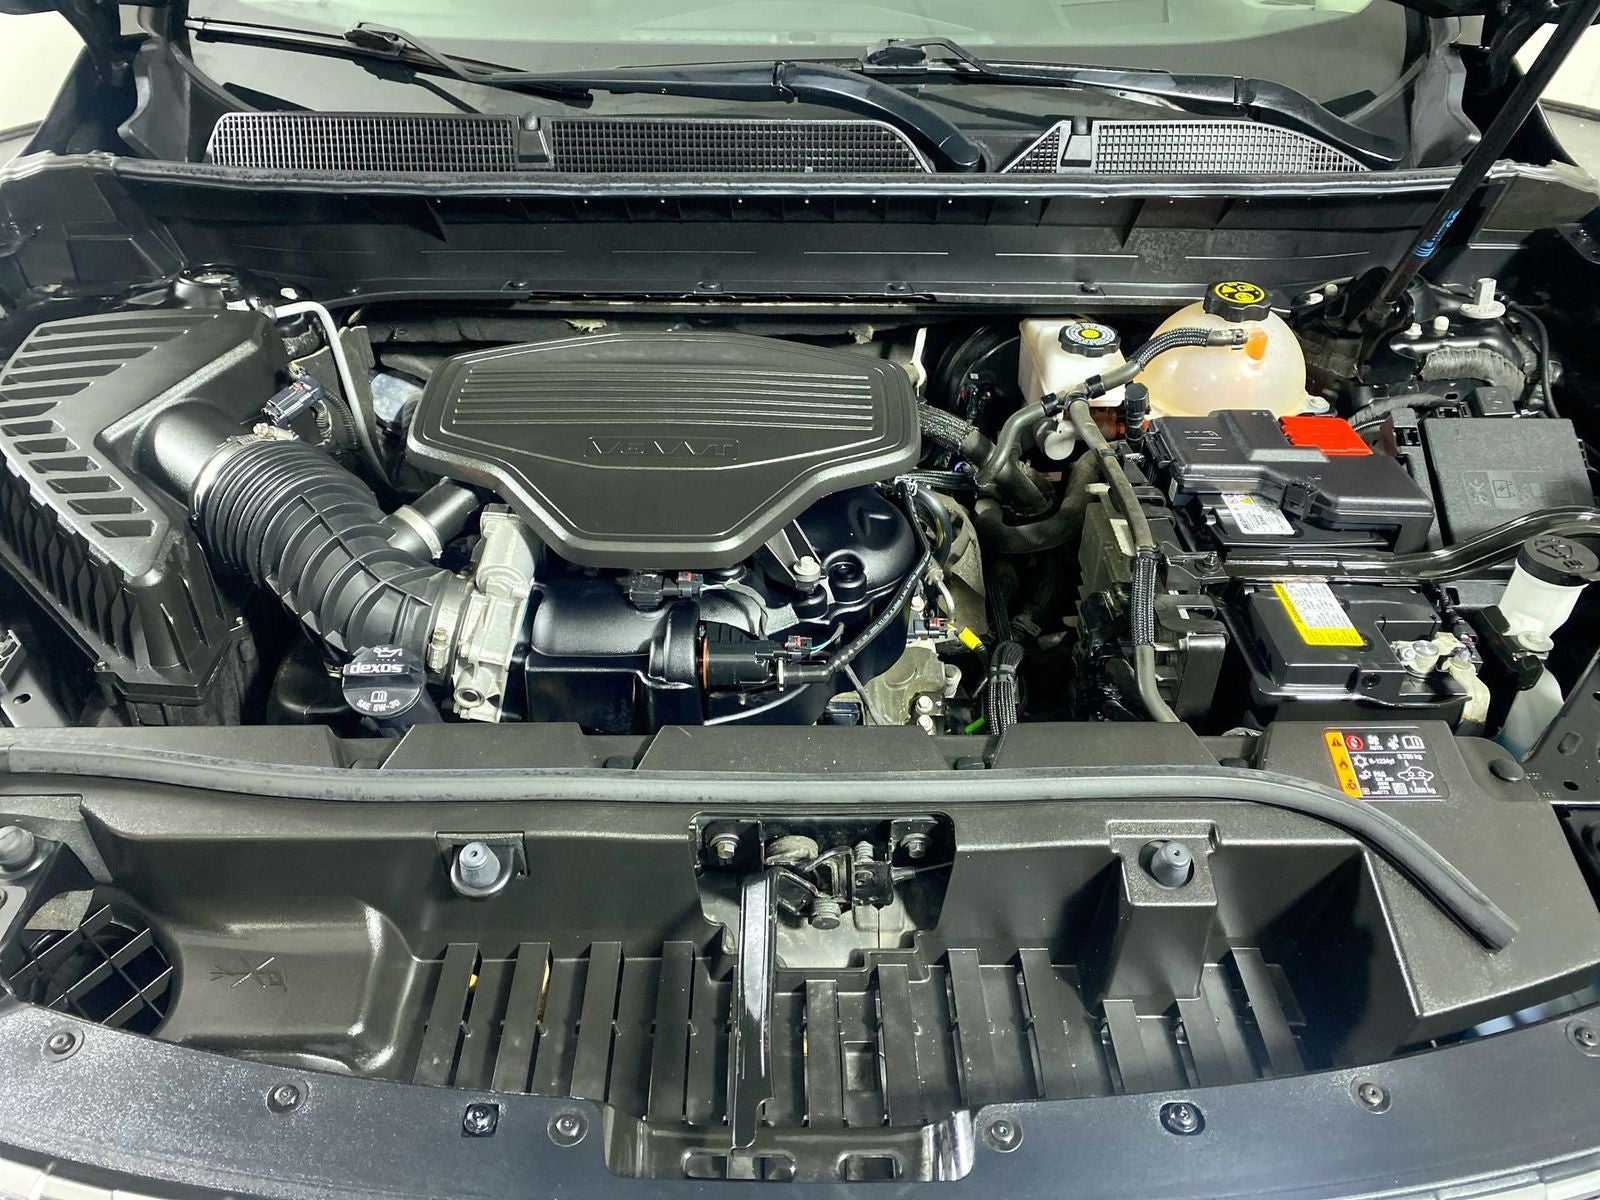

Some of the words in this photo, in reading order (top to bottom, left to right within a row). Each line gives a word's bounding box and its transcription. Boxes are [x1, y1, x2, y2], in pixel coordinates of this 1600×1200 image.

[349, 662, 405, 674] dexos
[356, 699, 371, 711] SAE
[372, 699, 400, 712] 5W-30
